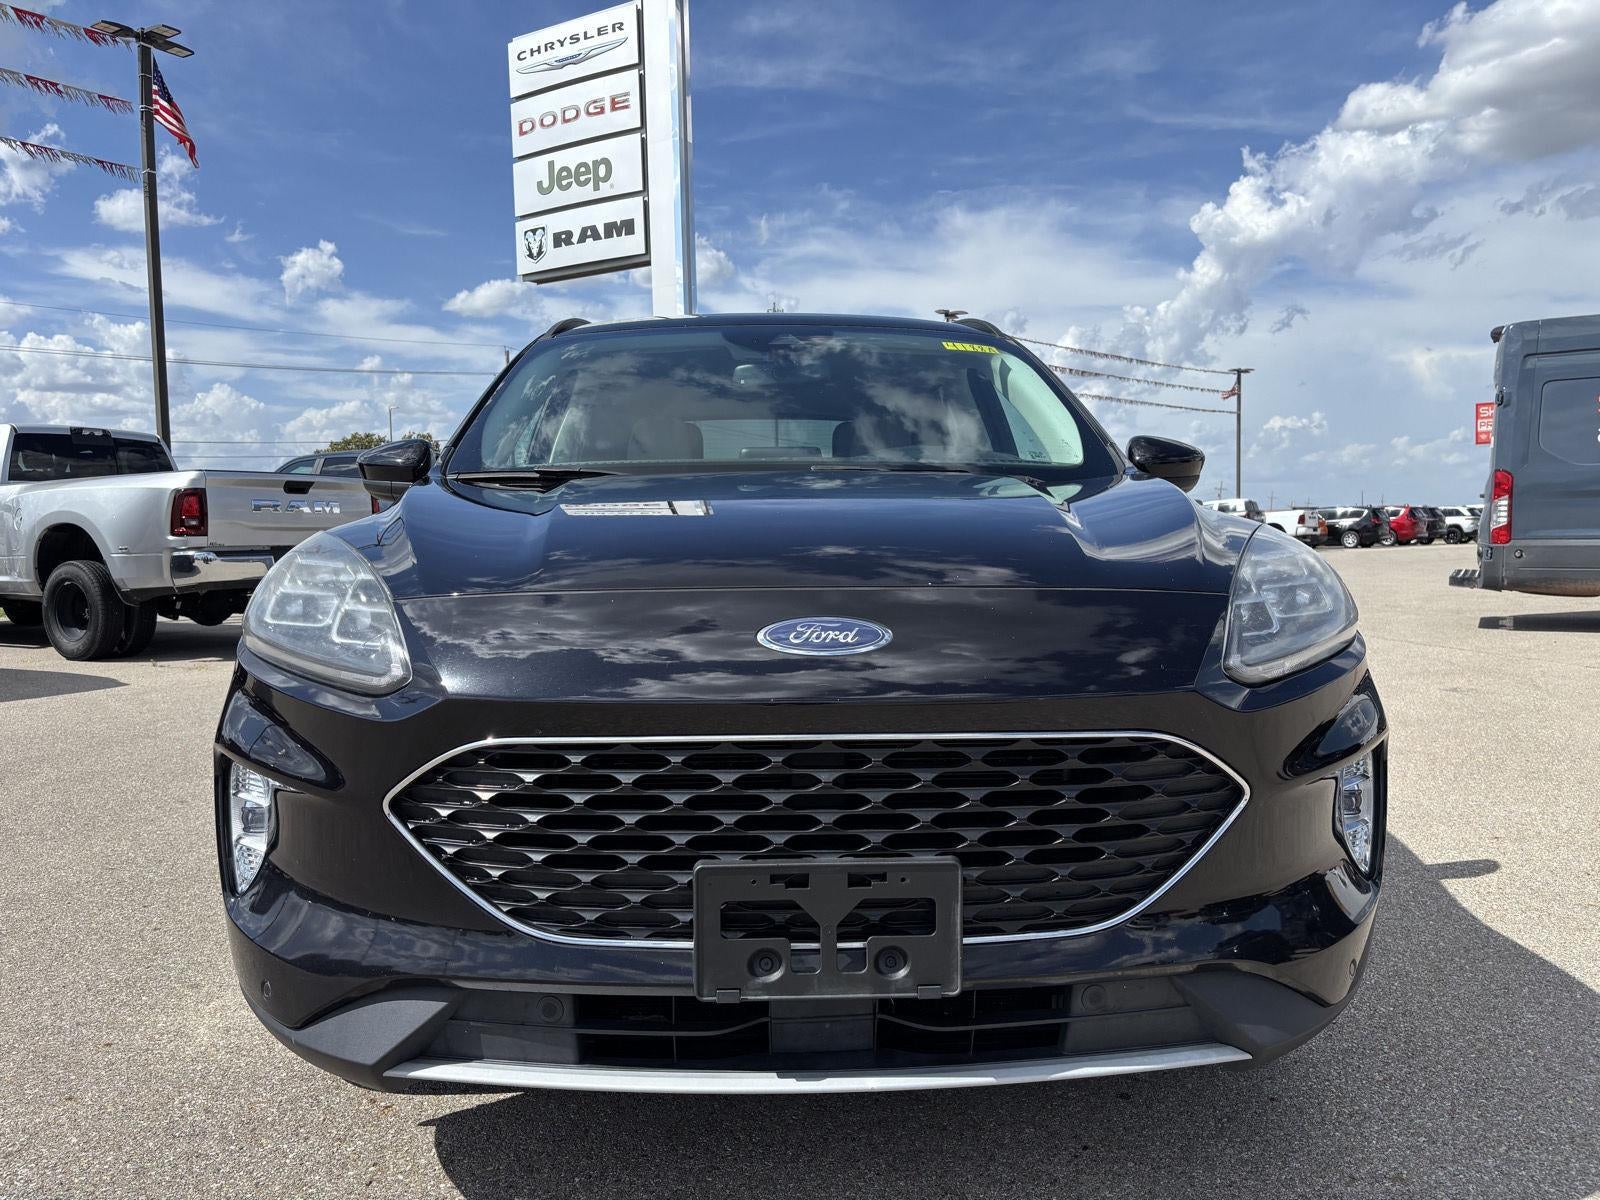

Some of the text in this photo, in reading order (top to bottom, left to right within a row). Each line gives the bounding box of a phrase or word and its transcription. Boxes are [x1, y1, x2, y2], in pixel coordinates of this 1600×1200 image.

[516, 21, 625, 62] CHRYSLER
[517, 91, 631, 137] DODGE
[536, 156, 613, 196] Jeep
[552, 217, 636, 249] RAM
[251, 499, 341, 514] RAM
[789, 622, 859, 644] Ford
